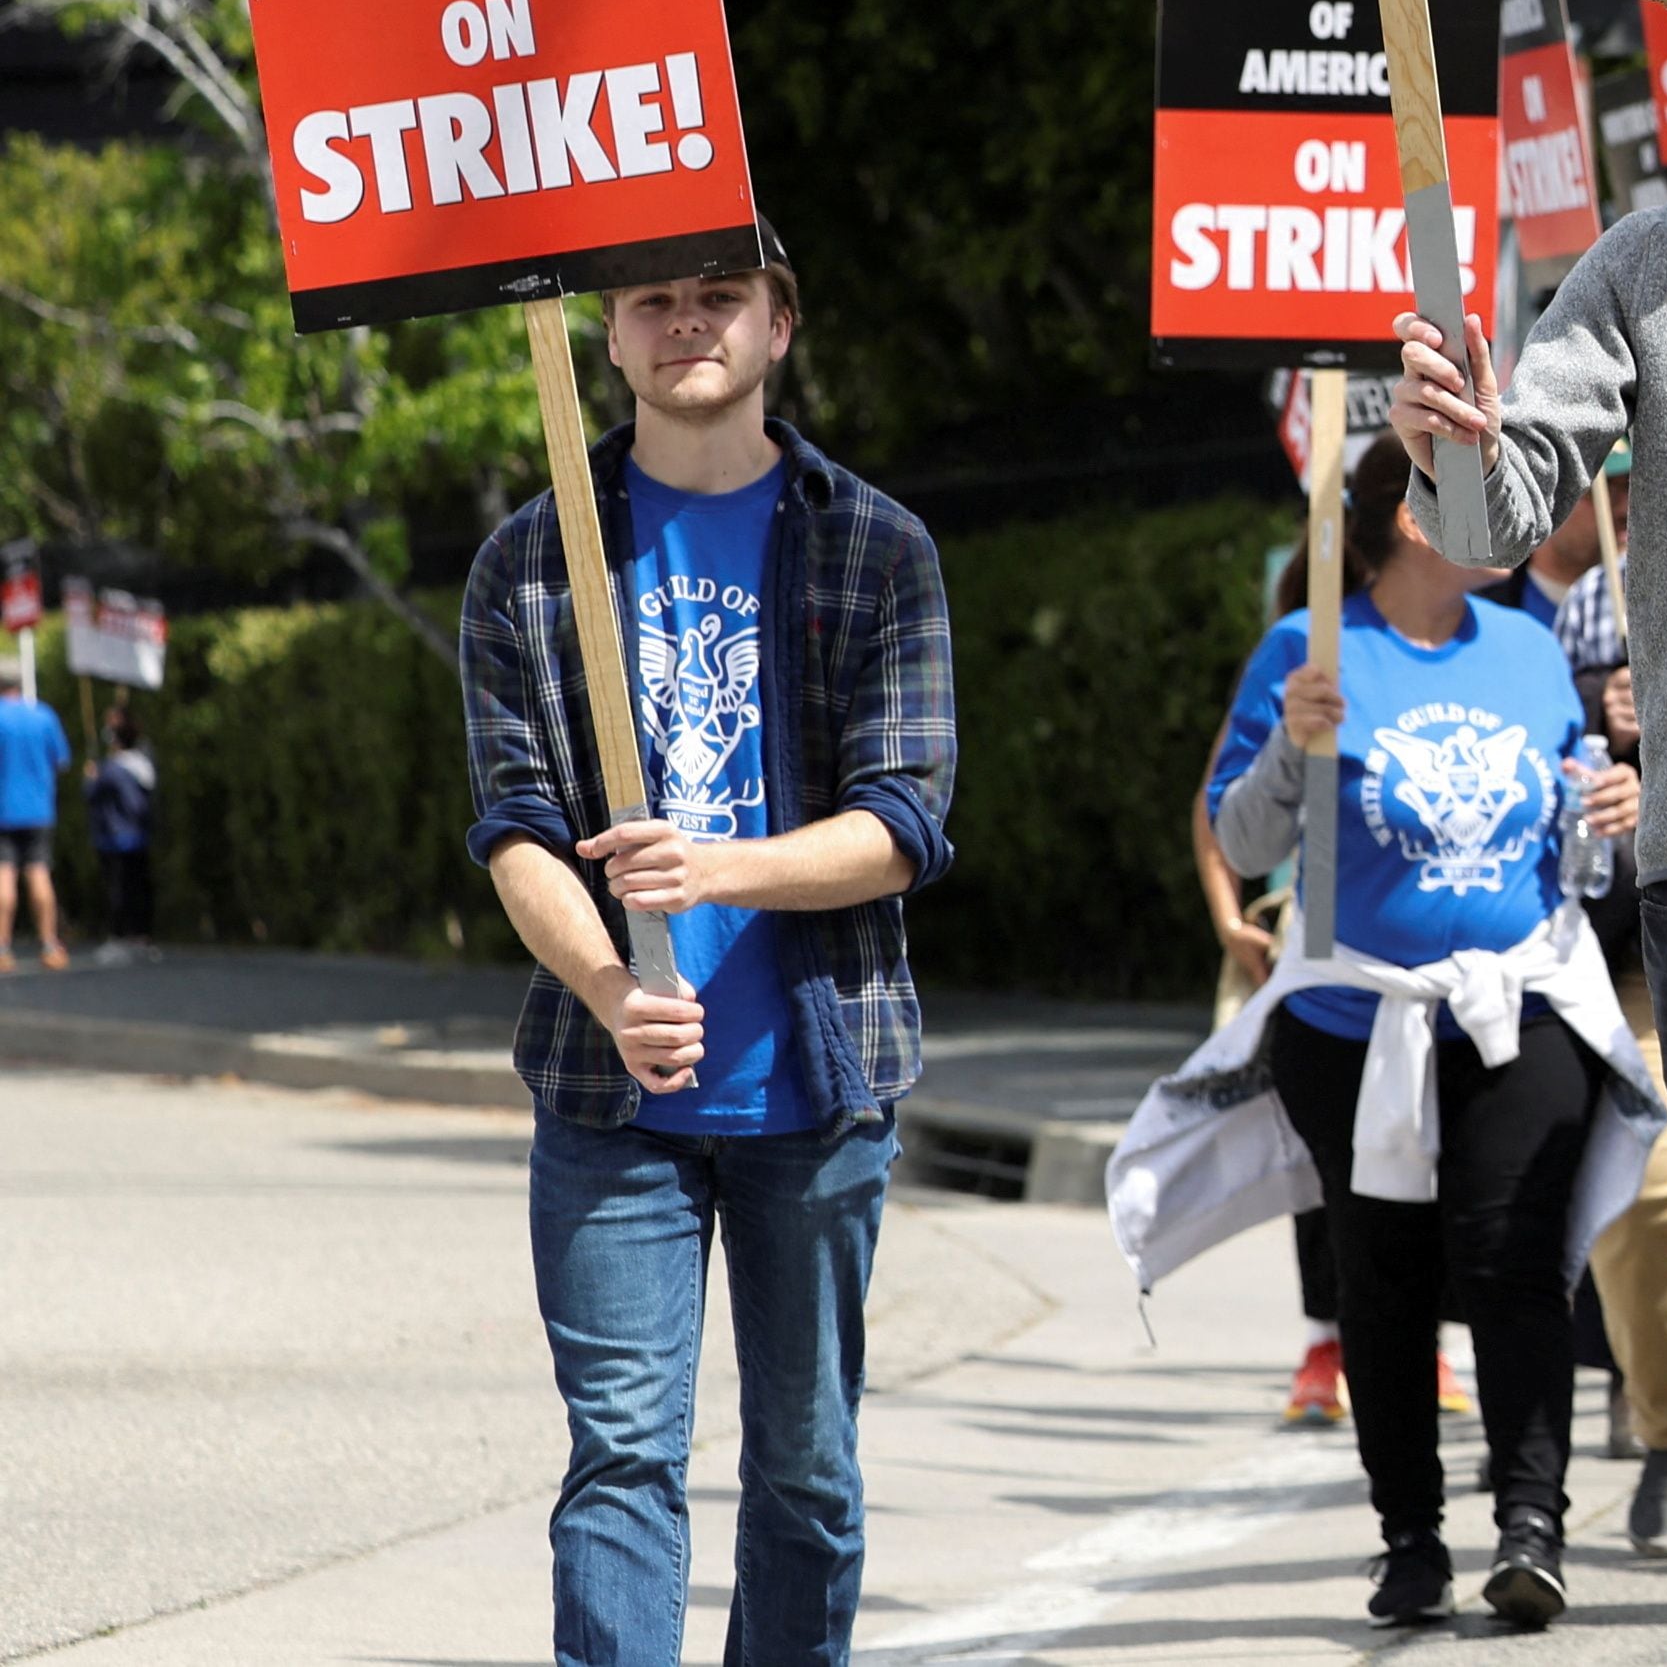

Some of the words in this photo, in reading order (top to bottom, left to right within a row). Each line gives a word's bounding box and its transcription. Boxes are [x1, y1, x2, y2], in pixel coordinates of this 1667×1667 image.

[1309, 1, 1353, 39] OF
[1240, 50, 1391, 96] AMERIC
[292, 51, 714, 224] STRIKE!
[1294, 141, 1366, 193] ON
[1170, 202, 1477, 294] STRIK!
[639, 575, 716, 618] GUILD
[721, 585, 760, 617] OF
[1397, 702, 1467, 733] GUILD
